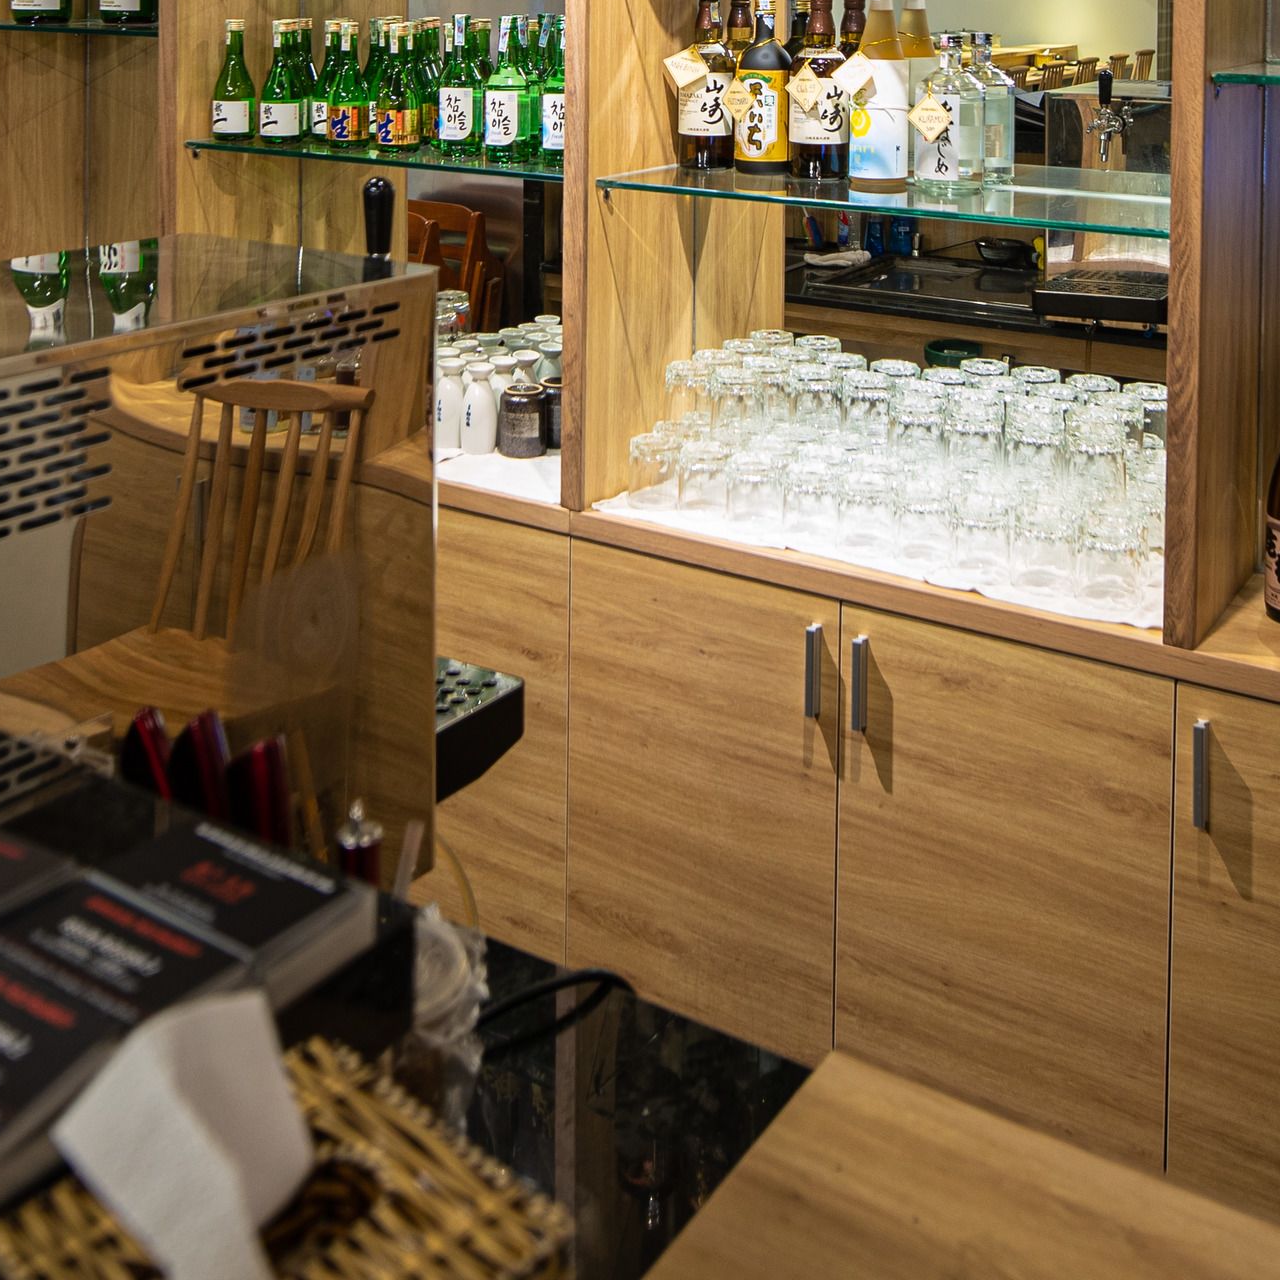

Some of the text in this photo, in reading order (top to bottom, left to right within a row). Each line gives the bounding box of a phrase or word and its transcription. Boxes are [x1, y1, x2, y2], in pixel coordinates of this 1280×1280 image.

[446, 94, 461, 112] 참
[490, 98, 505, 117] 참
[551, 101, 565, 120] 참
[331, 110, 350, 139] 生
[378, 113, 395, 143] 生
[447, 111, 467, 131] 이슬
[492, 116, 512, 136] 이슬
